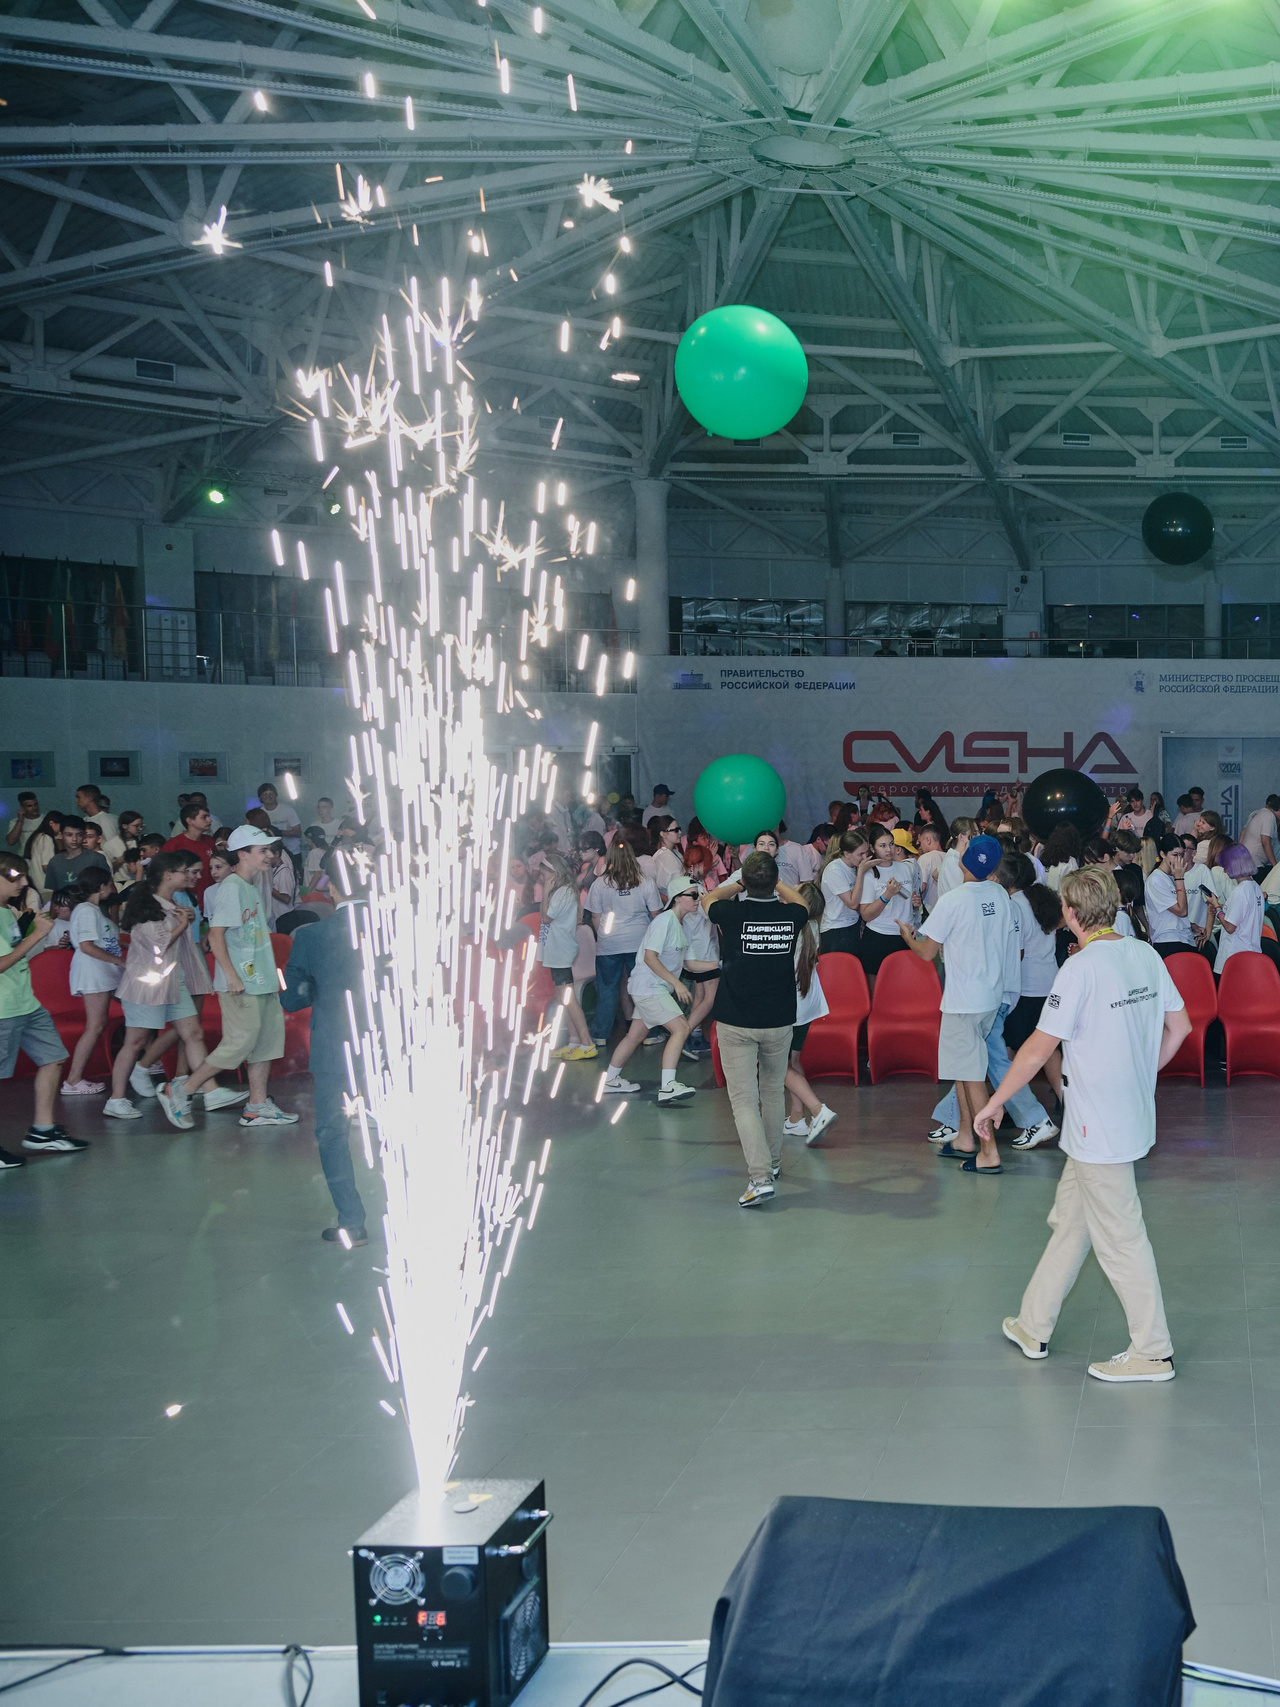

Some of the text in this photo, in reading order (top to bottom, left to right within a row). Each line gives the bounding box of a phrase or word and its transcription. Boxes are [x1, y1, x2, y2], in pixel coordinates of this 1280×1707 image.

[720, 669, 805, 678] ПРАВИТЕЛЬСТВО
[1158, 674, 1233, 683] МИНИСТЕРСТВО
[720, 680, 856, 691] РОССИЙСКОЙ ФЕДЕРАЦИИ
[1158, 683, 1279, 694] РОССИЙСКОЙ ФЕДЕРАЦИИ
[842, 730, 1139, 774] СМЕНА
[1223, 762, 1242, 774] 2024
[869, 782, 991, 795] серосийский
[746, 925, 792, 933] ДИРЕКЦИЯ
[740, 933, 795, 941] КРЕАТИВНЫХ
[746, 942, 789, 950] ПРОГРАММ
